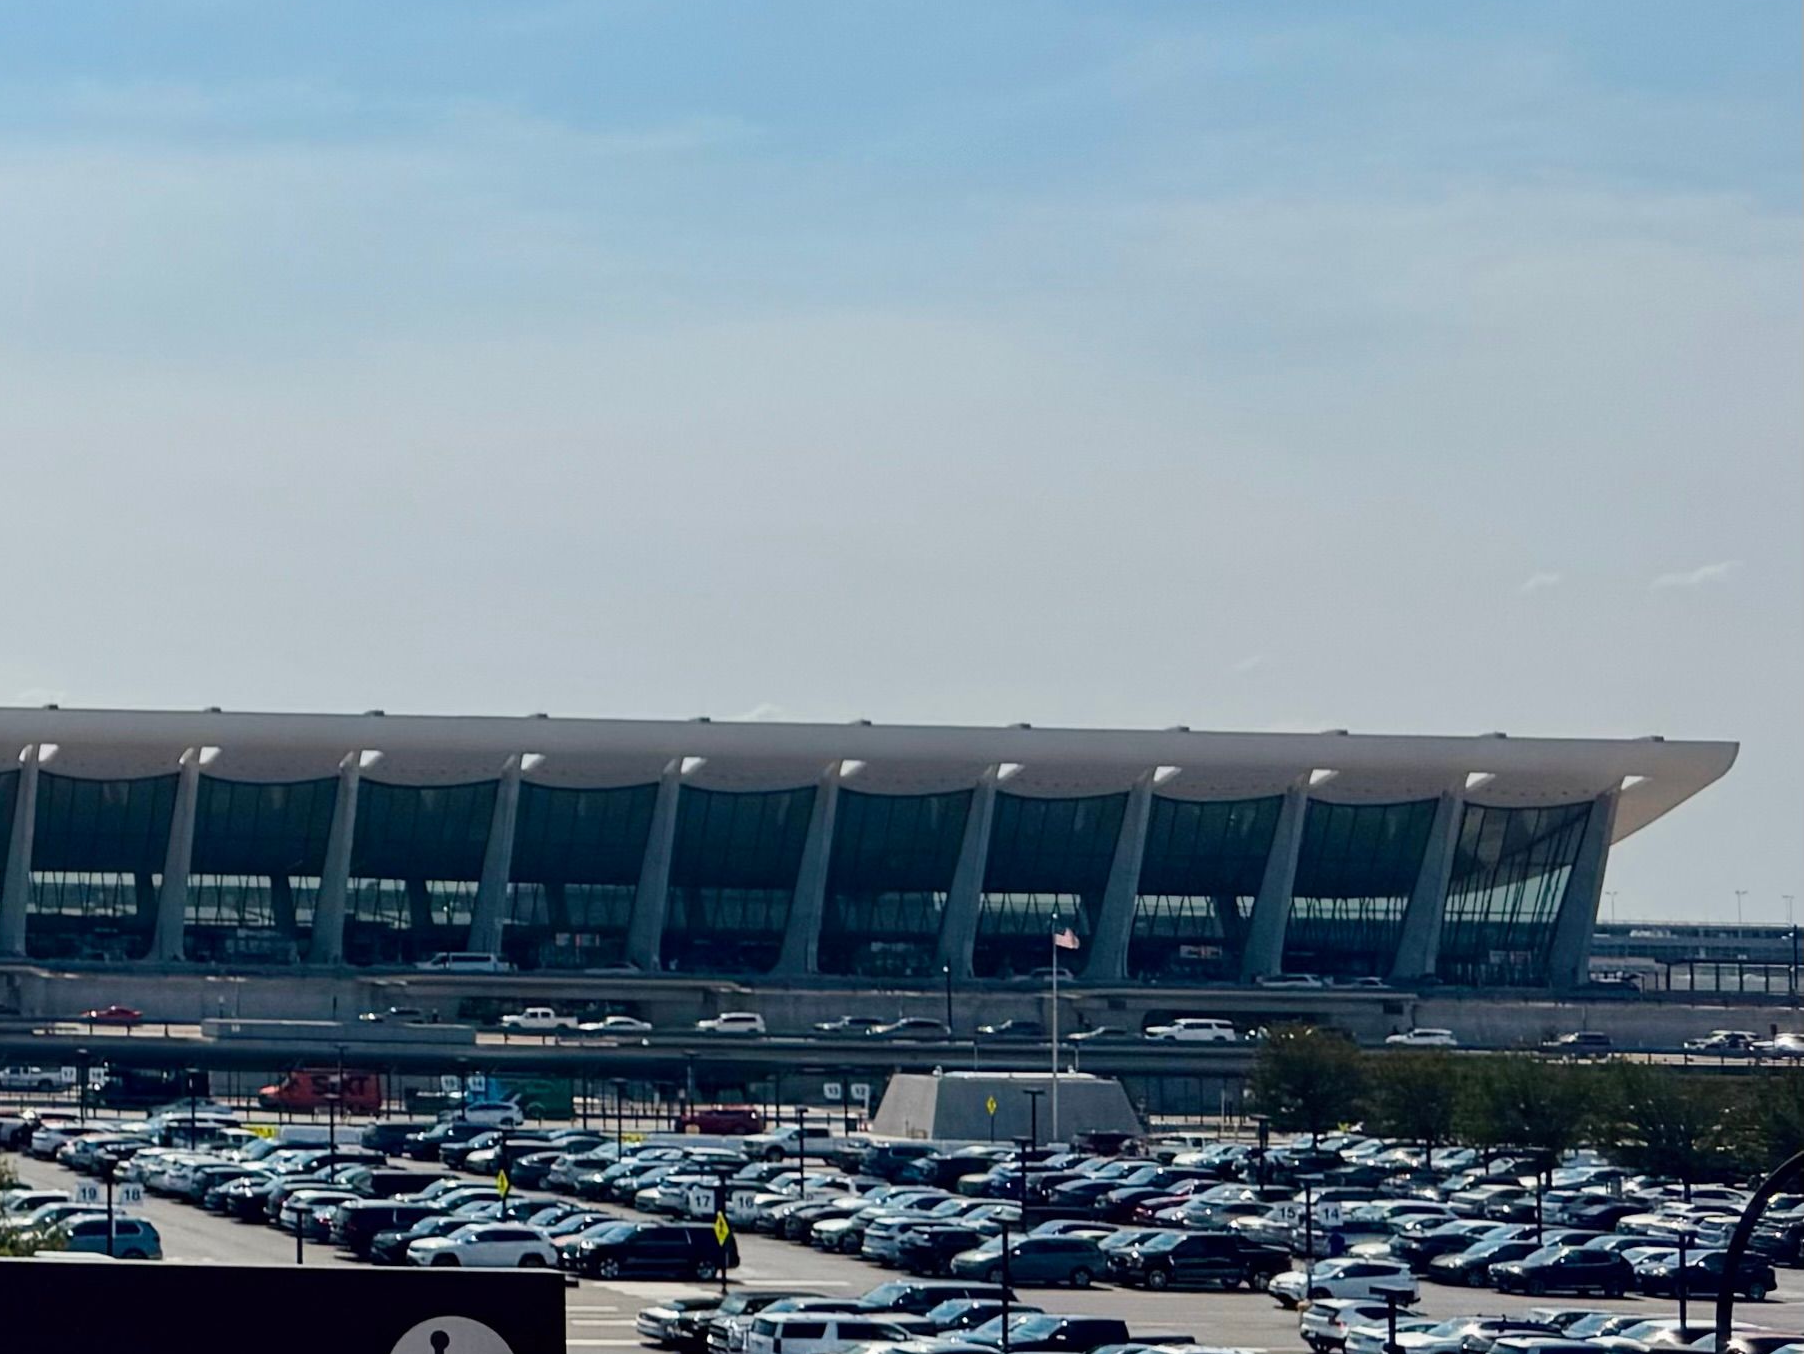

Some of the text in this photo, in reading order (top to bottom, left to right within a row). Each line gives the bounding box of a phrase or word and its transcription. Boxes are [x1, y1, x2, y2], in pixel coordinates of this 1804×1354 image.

[81, 1187, 97, 1200] 19
[124, 1188, 140, 1201] 18
[695, 1195, 710, 1208] 17
[739, 1196, 753, 1209] 16
[1280, 1207, 1295, 1219] 15
[1324, 1208, 1339, 1220] 14
